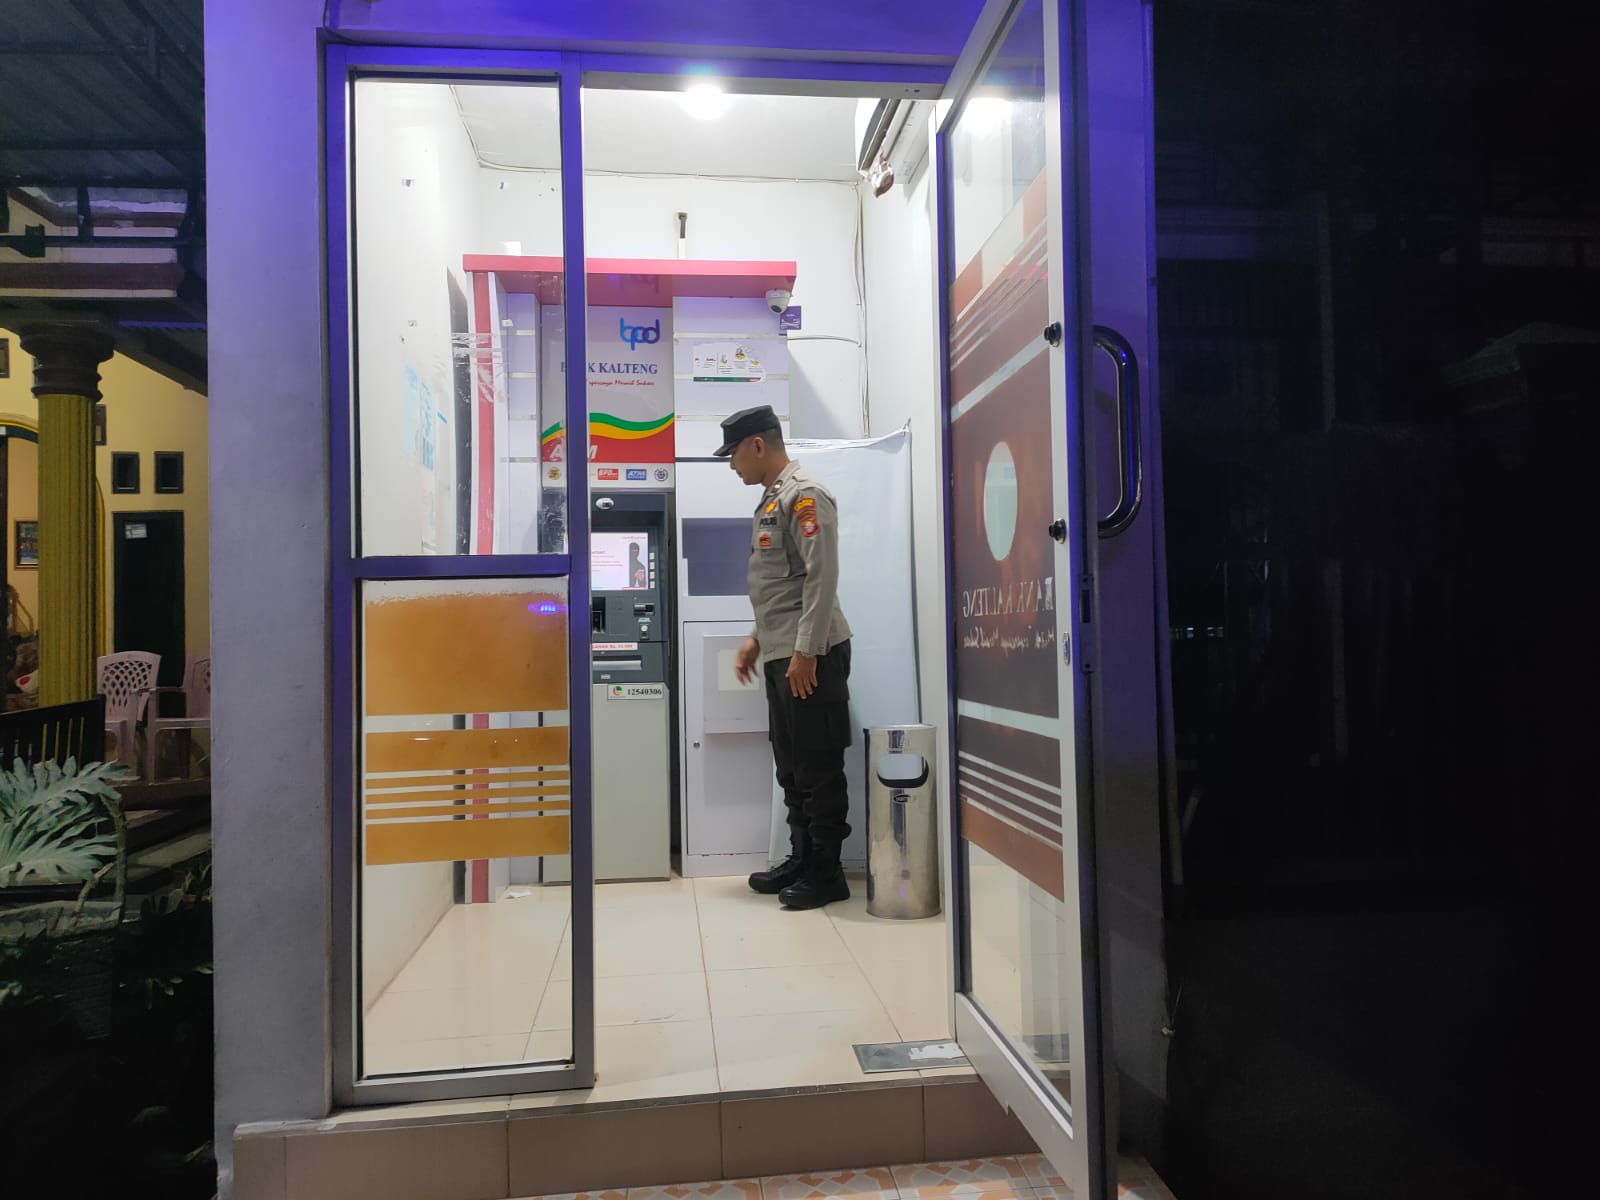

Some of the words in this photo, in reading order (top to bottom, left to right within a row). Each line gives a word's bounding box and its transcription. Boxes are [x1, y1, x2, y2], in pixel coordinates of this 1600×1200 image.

[619, 317, 661, 350] bpd
[599, 362, 658, 375] KALTENG
[627, 688, 662, 696] 12540306
